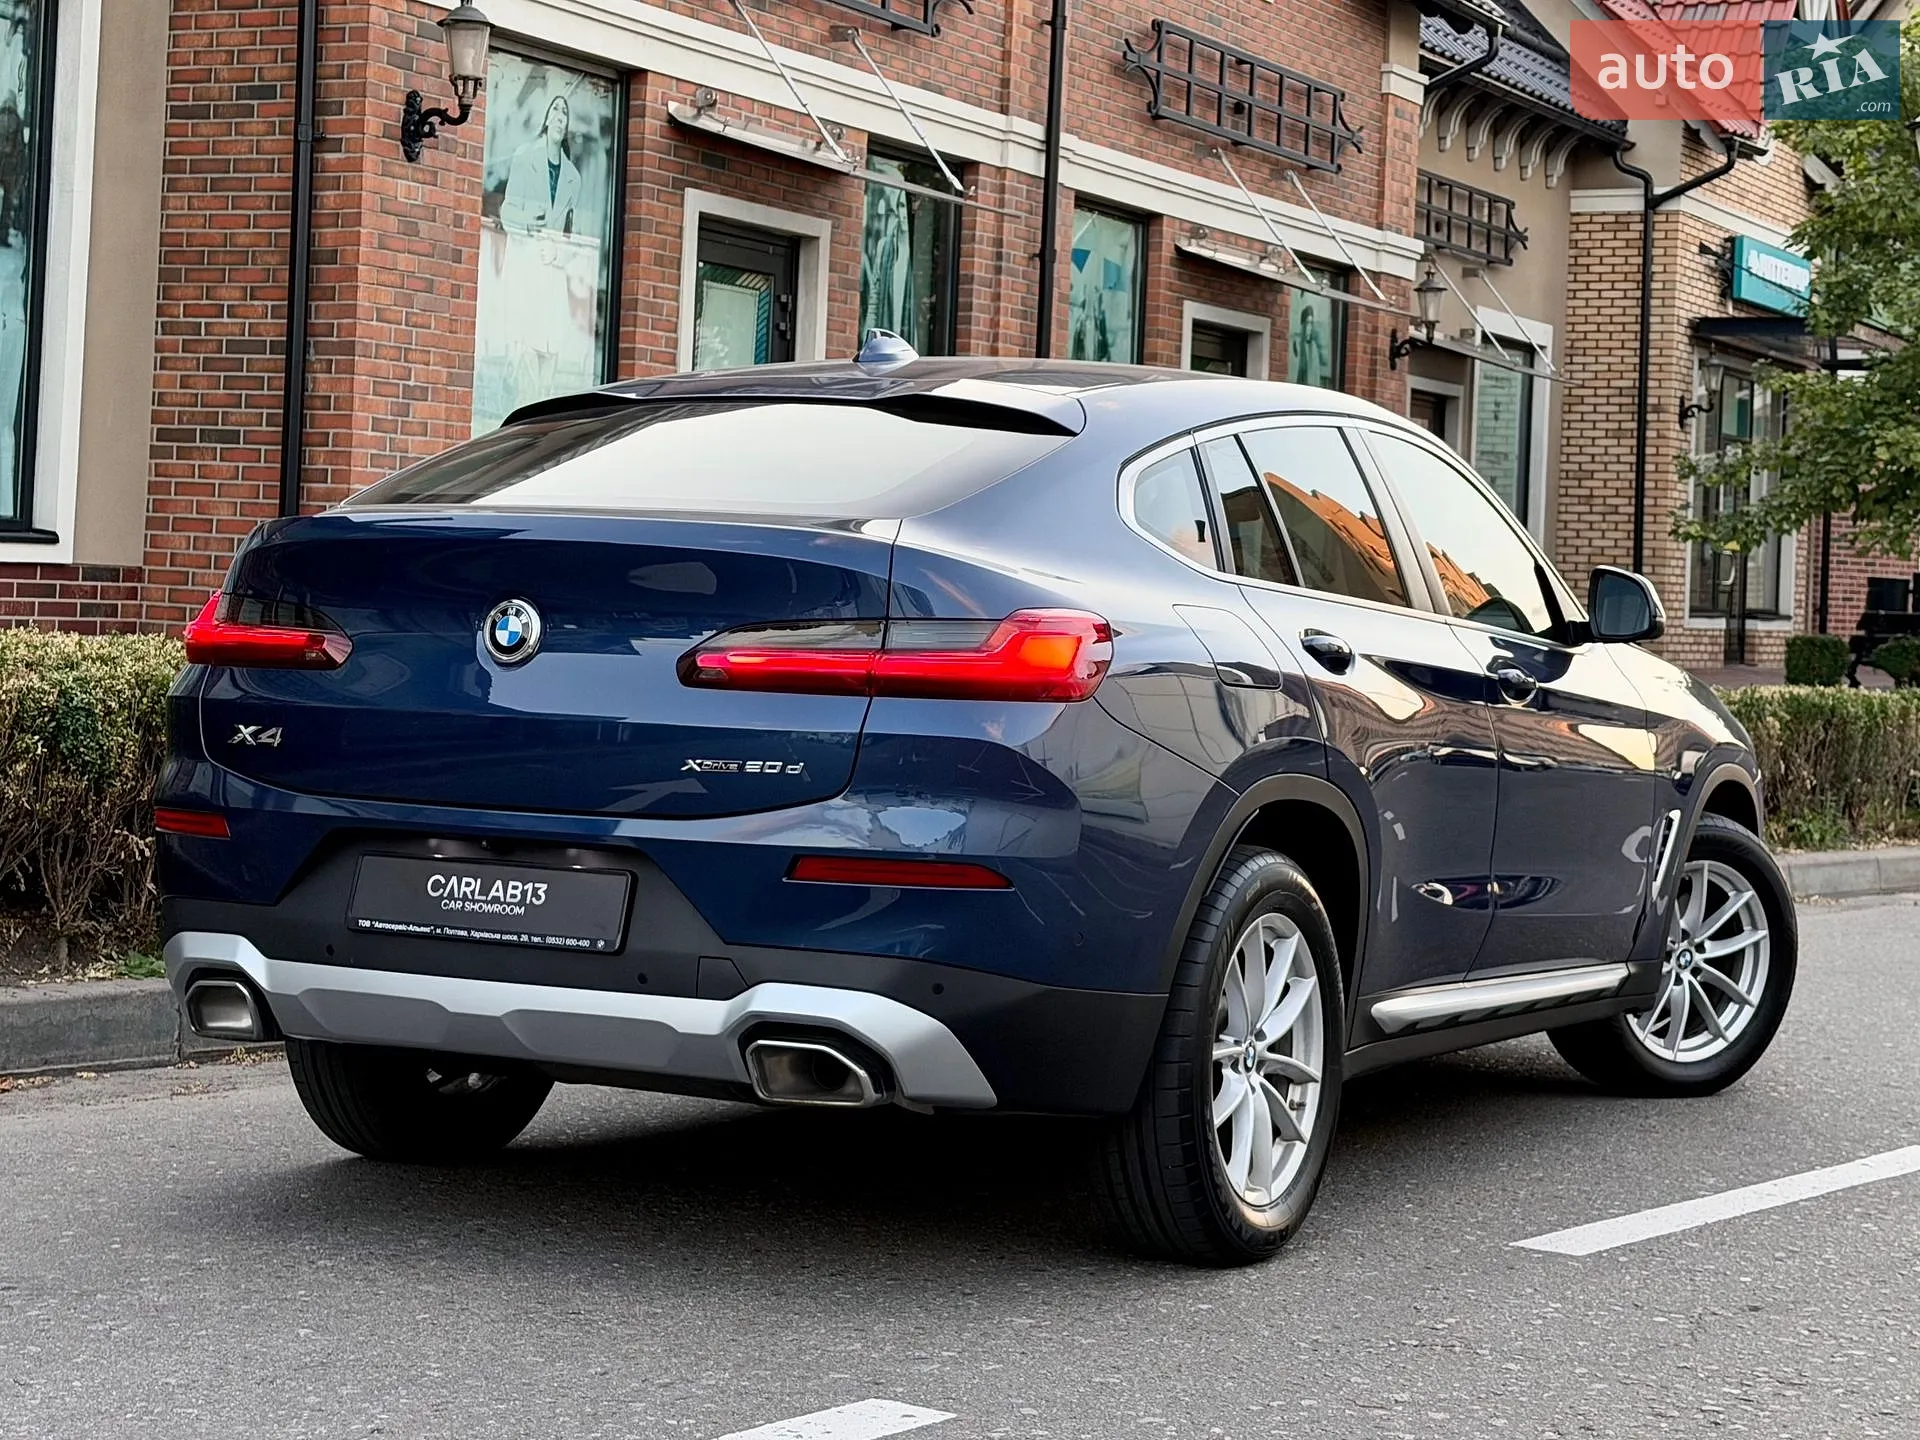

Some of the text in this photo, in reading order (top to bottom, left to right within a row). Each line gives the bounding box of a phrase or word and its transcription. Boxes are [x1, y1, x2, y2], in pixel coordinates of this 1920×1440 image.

[494, 607, 529, 624] BMW
[227, 724, 283, 747] X4
[426, 873, 549, 906] CARLAB13
[440, 898, 525, 917] CAR SHOWROOM
[357, 919, 371, 927] ТОВ
[545, 935, 565, 946] (0532)
[565, 937, 590, 948] 600-400
